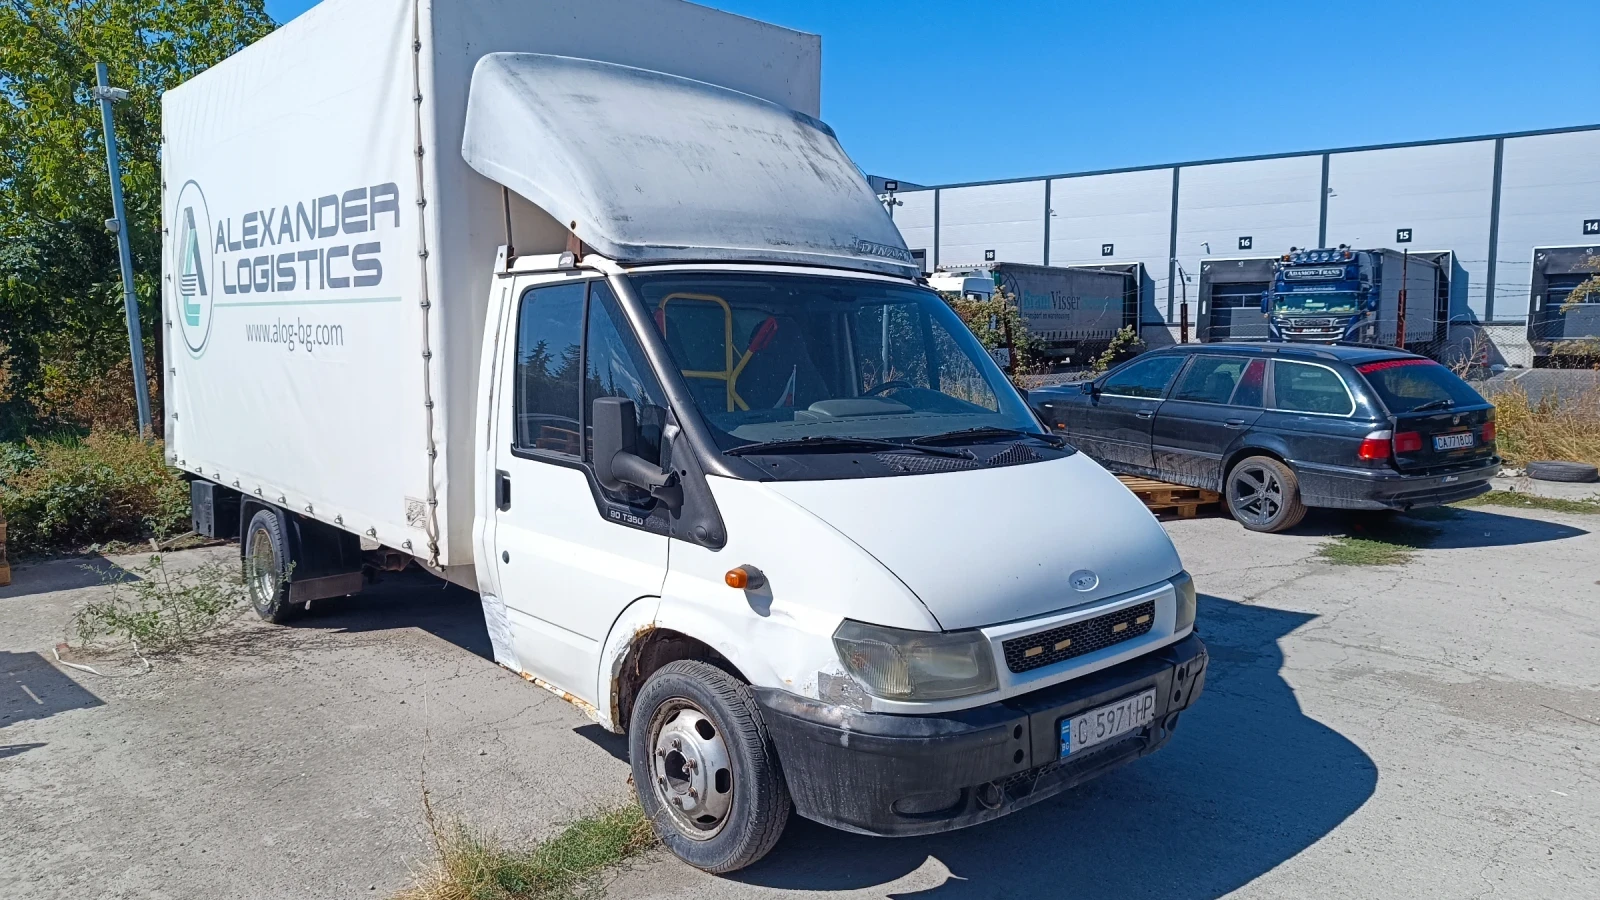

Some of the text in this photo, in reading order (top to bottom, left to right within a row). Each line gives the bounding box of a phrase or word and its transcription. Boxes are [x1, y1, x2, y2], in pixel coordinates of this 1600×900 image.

[215, 182, 400, 254] ALEXANDER
[1585, 222, 1598, 231] 14
[1398, 231, 1409, 240] 15
[1240, 238, 1250, 247] 16
[986, 251, 994, 259] 18
[1103, 246, 1112, 254] 17
[222, 242, 383, 294] LOGISTICS
[245, 317, 344, 352] www.alog-bg.com
[622, 513, 644, 526] T350
[1078, 718, 1088, 745] C
[1096, 702, 1132, 738] 5971
